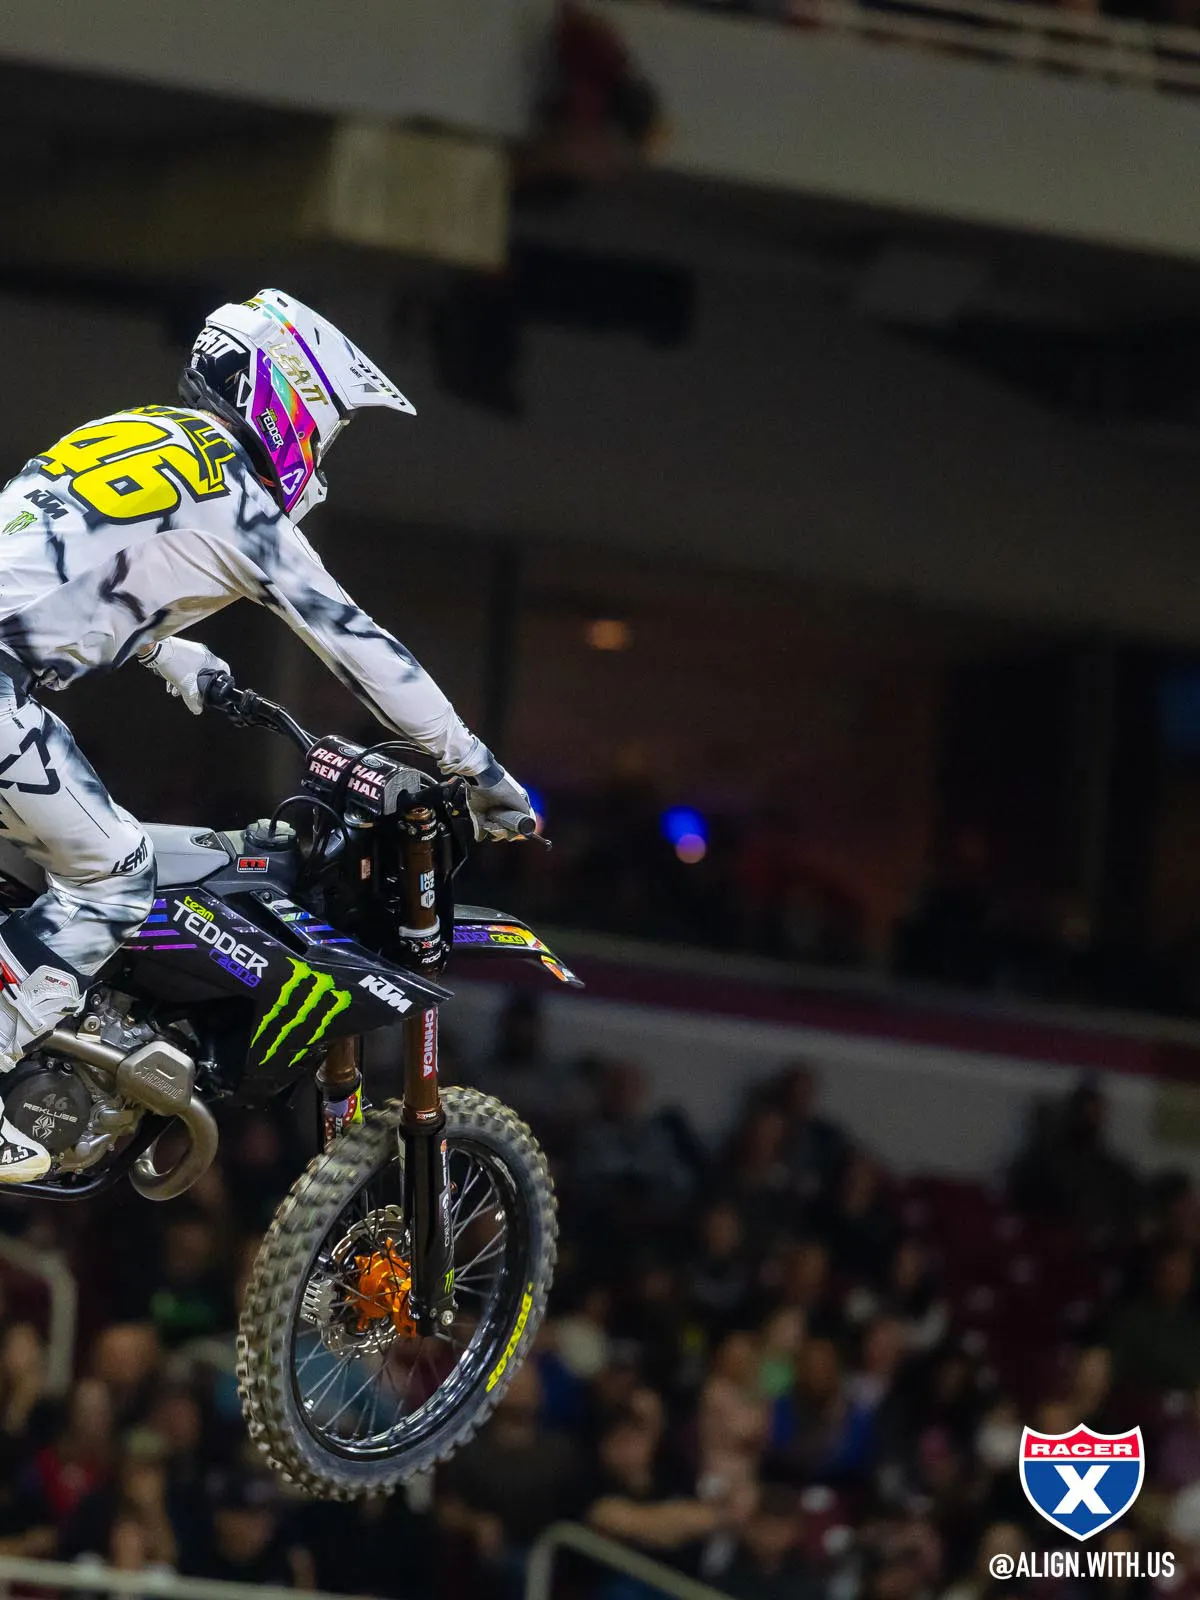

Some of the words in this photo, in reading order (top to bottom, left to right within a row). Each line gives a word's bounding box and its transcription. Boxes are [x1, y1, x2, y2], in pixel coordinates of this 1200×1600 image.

[192, 327, 247, 359] EATT
[268, 341, 328, 406] LEATT
[261, 408, 284, 449] TEDDER
[37, 420, 231, 524] 46
[24, 489, 69, 520] KTM
[111, 835, 148, 874] LEATT
[240, 859, 266, 868] ETS
[184, 896, 214, 921] team
[173, 899, 269, 978] TEDDER
[209, 948, 260, 988] racing
[358, 974, 413, 1013] KTM
[23, 1102, 78, 1123] REKLUSE
[42, 1094, 69, 1111] 46
[1, 1146, 29, 1164] 4.5
